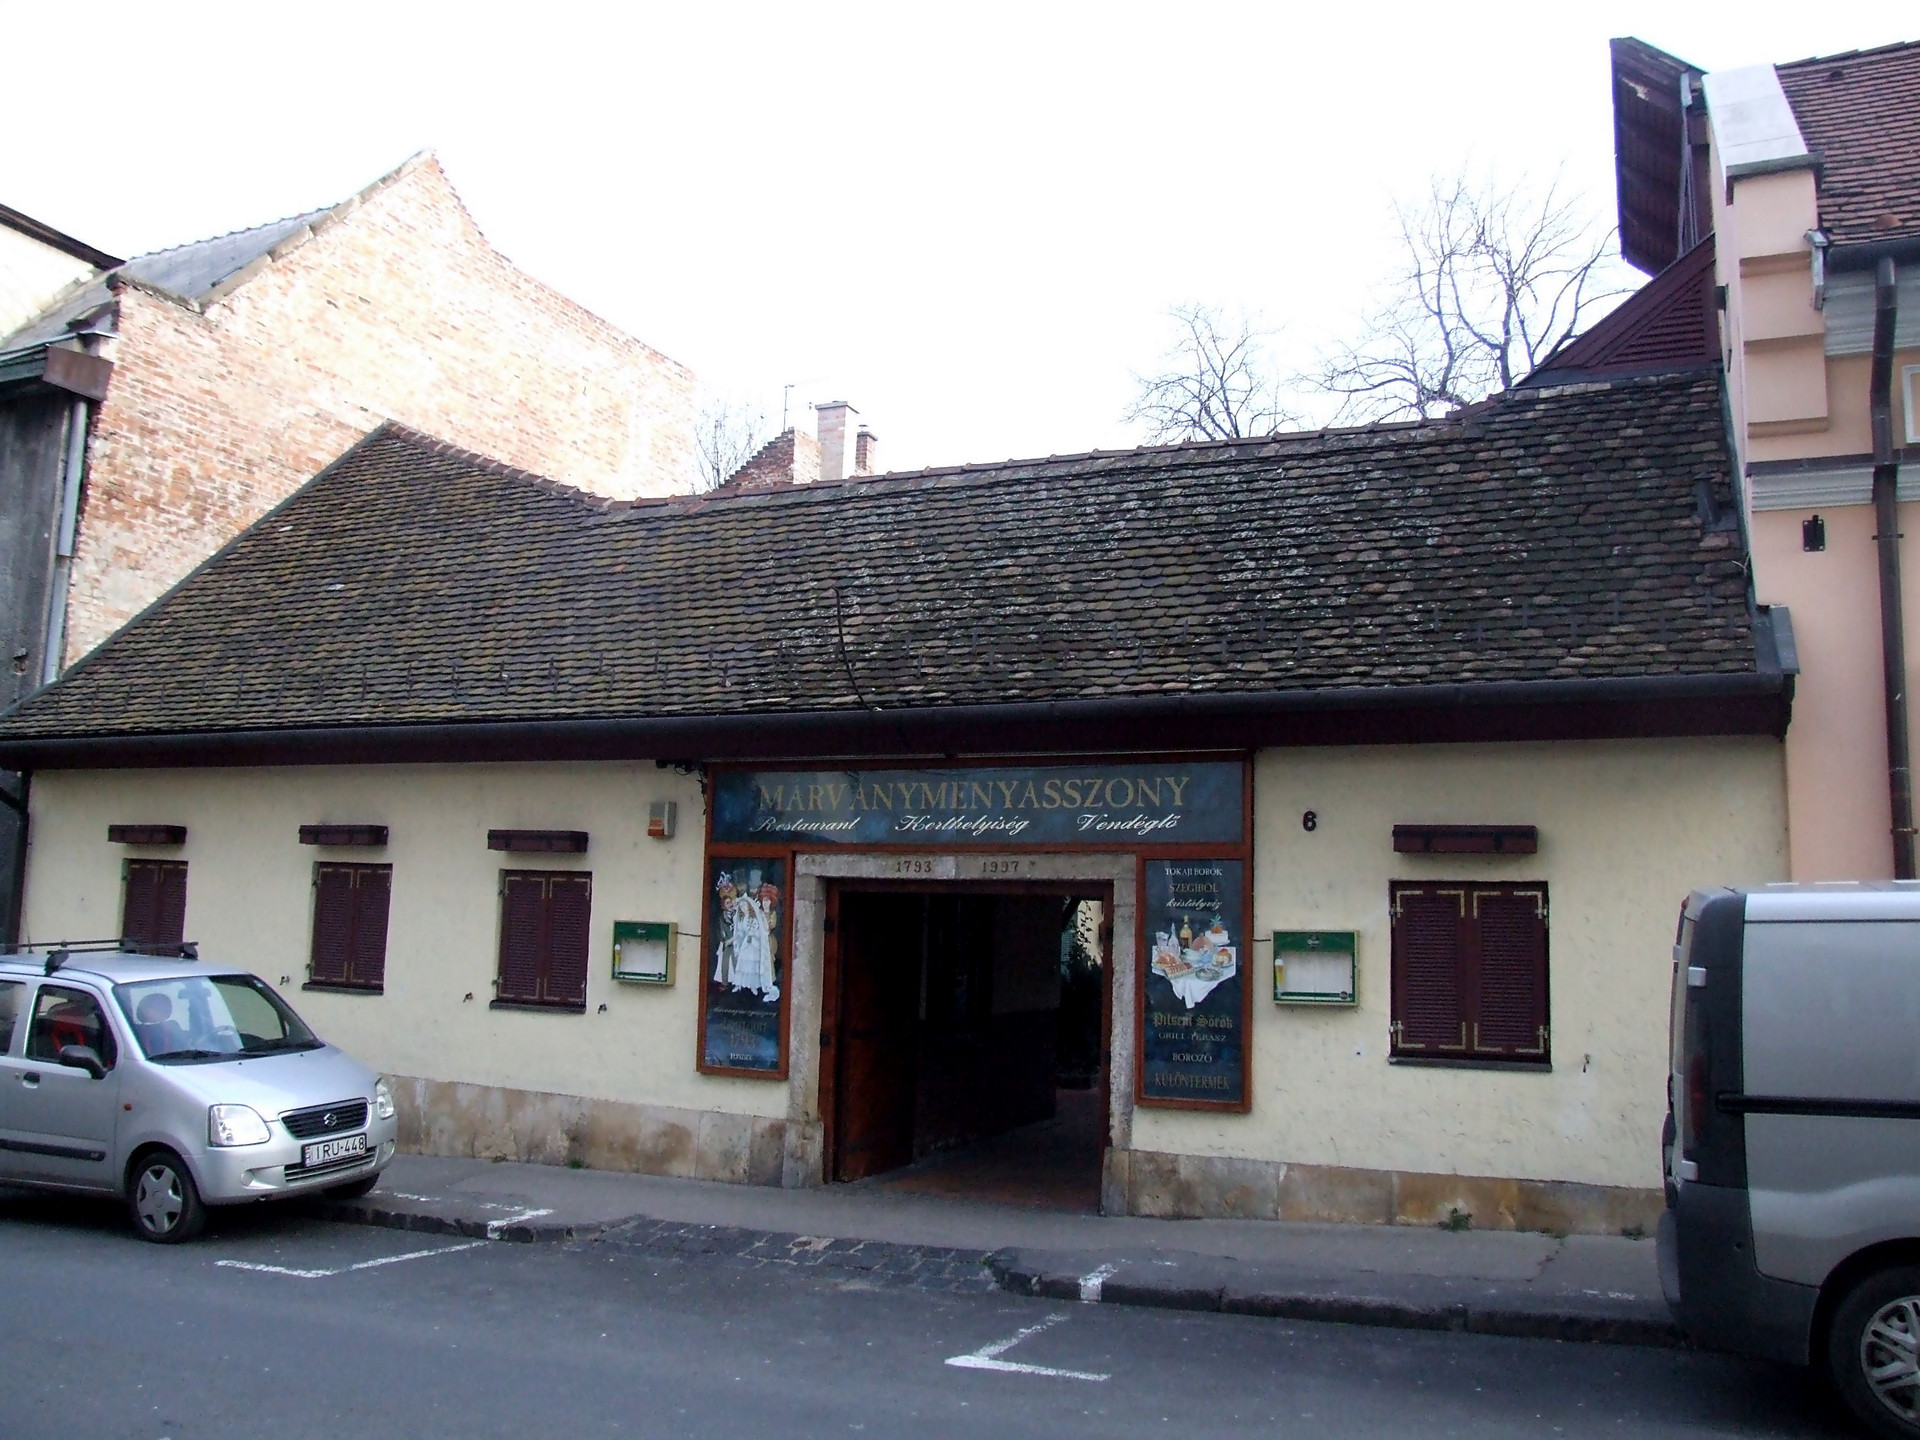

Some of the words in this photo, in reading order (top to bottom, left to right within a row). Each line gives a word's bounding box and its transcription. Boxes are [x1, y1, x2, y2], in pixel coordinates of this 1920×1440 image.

[750, 816, 861, 833] Restaurant
[895, 814, 1030, 836] Kerthelyiség
[1076, 813, 1181, 836] Vendéglő
[1302, 811, 1317, 832] 6
[896, 860, 932, 873] 1793
[982, 860, 1019, 874] 1997
[1165, 868, 1193, 876] TOKAJI
[1194, 868, 1222, 876] BOROK
[1172, 1052, 1212, 1063] BOROZÓ
[316, 1136, 365, 1160] IRU-448
